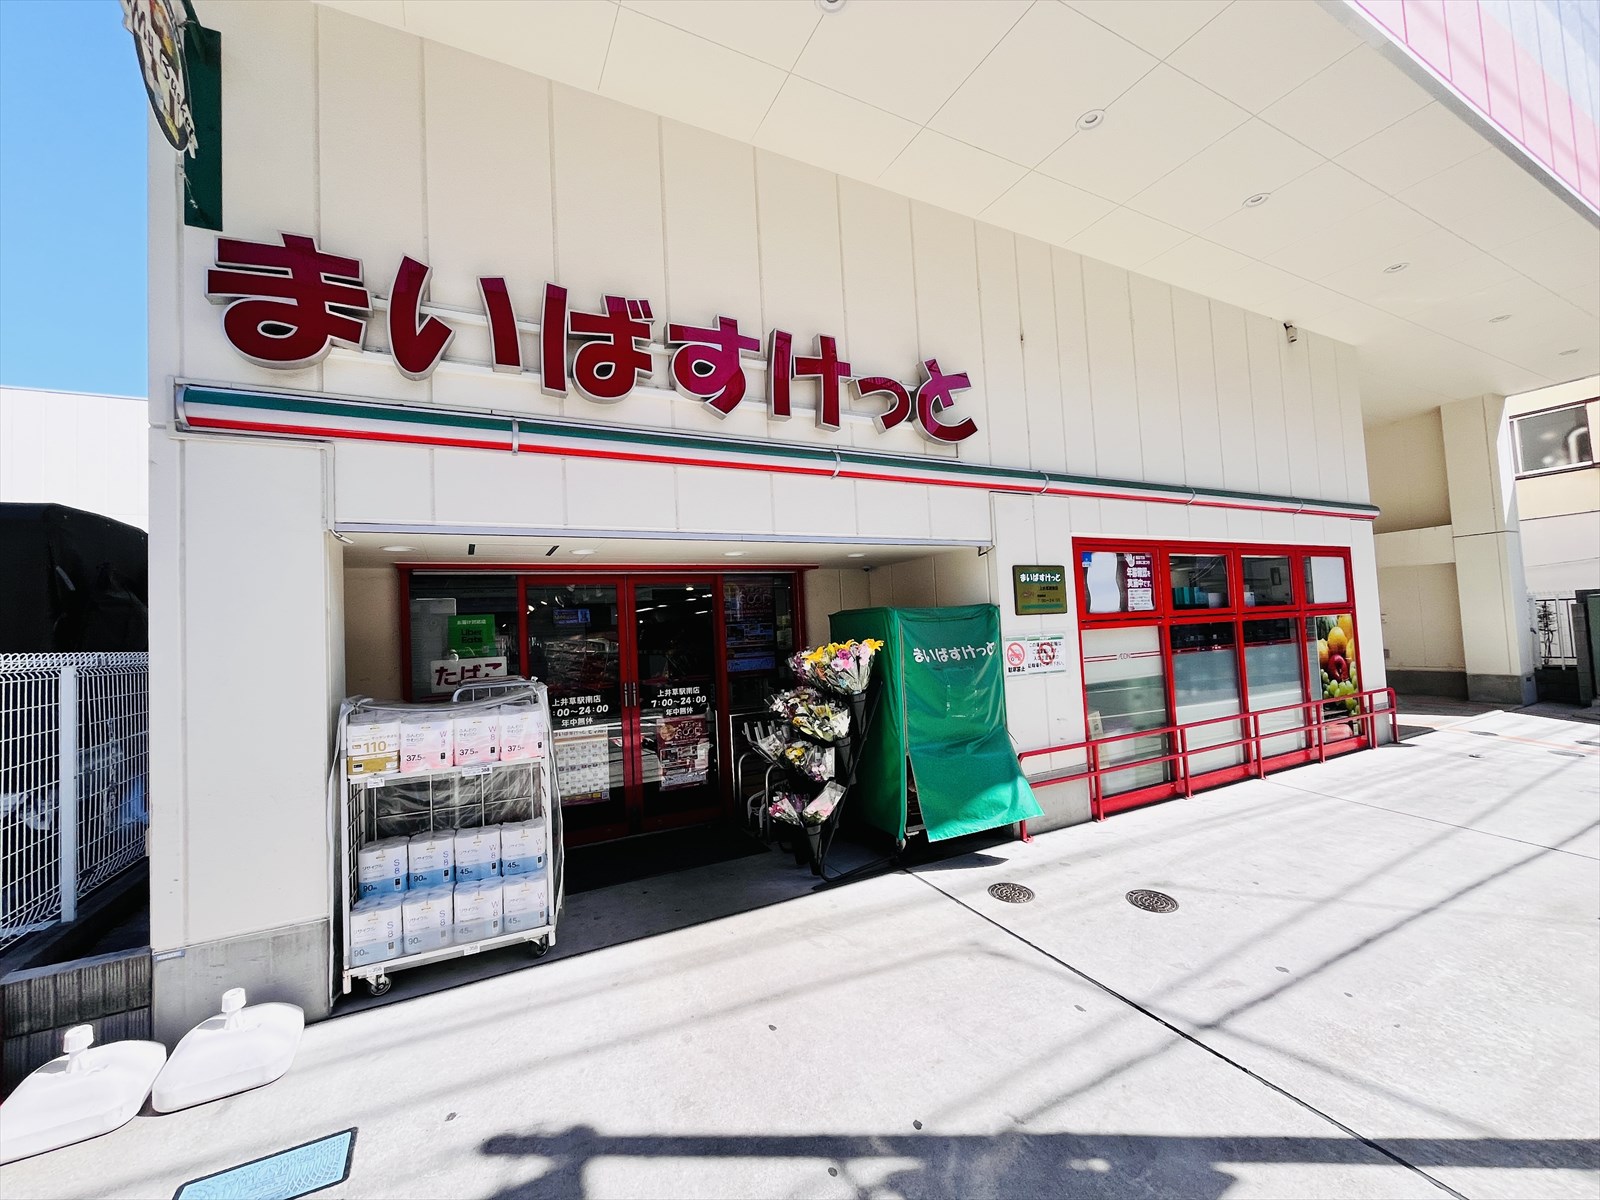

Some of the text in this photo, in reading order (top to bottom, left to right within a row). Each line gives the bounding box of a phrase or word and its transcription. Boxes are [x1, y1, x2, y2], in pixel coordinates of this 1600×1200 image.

[206, 232, 979, 445] まいばすけっと
[1019, 572, 1062, 583] まいばすけっと
[461, 628, 482, 636] Uber
[461, 636, 484, 644] Eats
[913, 641, 995, 663] まいばすけっと
[657, 686, 700, 698] 上井草駅南店
[552, 695, 601, 707] 上井草駅南店
[552, 704, 609, 717] :00〜24:00
[665, 706, 694, 716] 年中無休
[561, 717, 594, 727] 年中無休
[488, 725, 497, 733] W
[363, 740, 387, 753] 110
